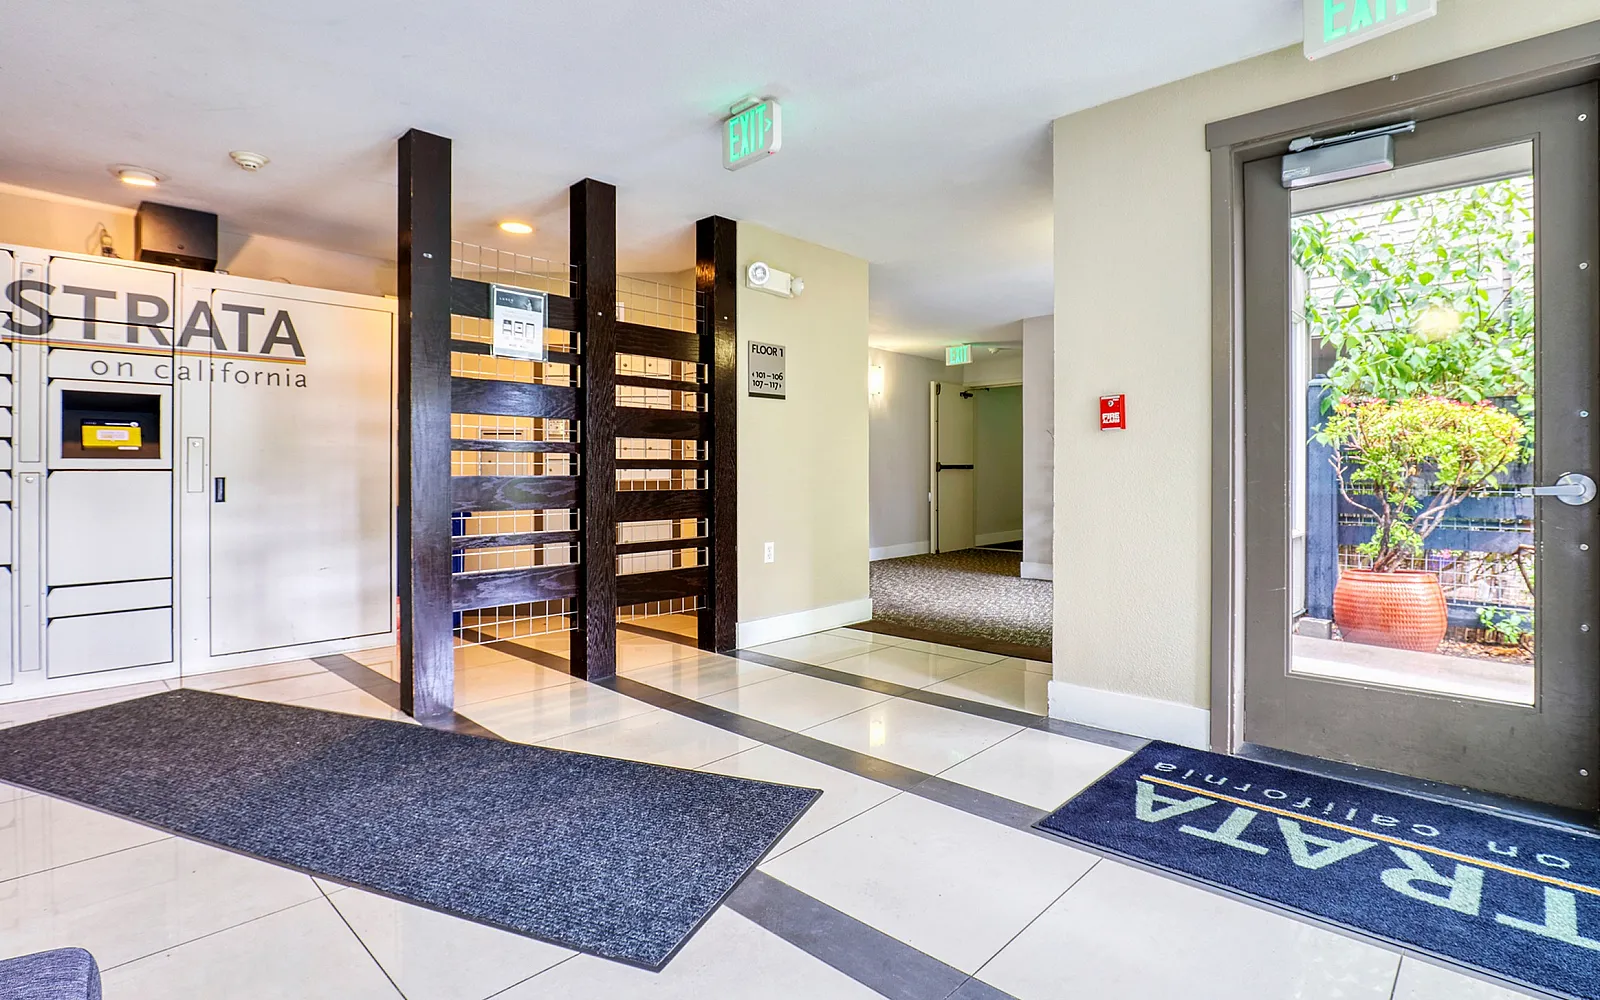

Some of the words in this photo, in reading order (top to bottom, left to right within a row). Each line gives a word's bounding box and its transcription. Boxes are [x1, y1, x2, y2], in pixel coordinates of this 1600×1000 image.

[1323, 0, 1408, 43] EX
[729, 103, 767, 163] EXIT
[2, 280, 306, 357] STRATA
[752, 344, 777, 357] FLOOR
[779, 348, 784, 357] 1
[950, 345, 968, 364] EXIT
[91, 360, 133, 377] on
[154, 359, 307, 388] california
[1154, 762, 1440, 837] california
[1488, 841, 1570, 869] on
